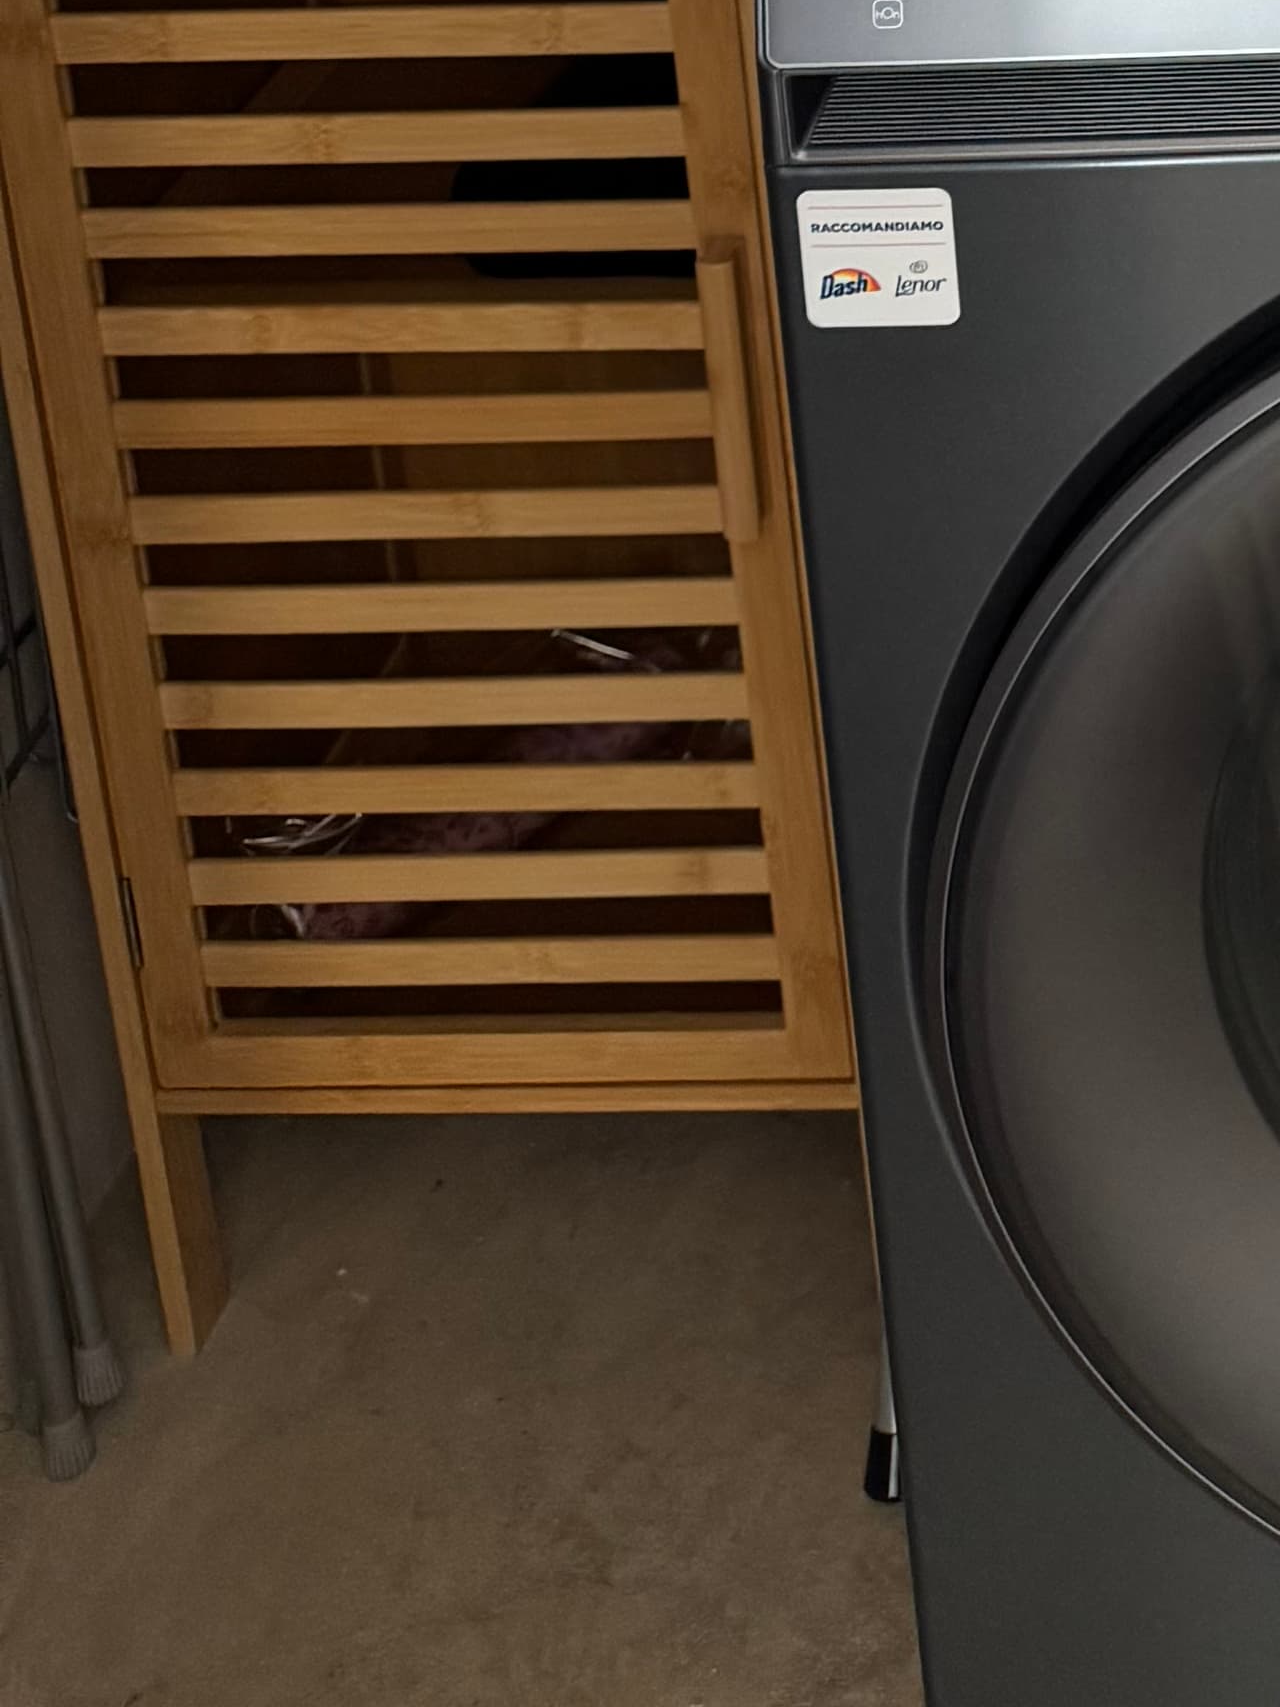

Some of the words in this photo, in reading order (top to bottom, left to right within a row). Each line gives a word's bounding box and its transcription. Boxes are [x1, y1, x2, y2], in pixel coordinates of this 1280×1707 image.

[810, 220, 944, 234] RACCOMANDIAMO
[820, 271, 868, 300] Dash
[895, 274, 947, 298] Lenor
